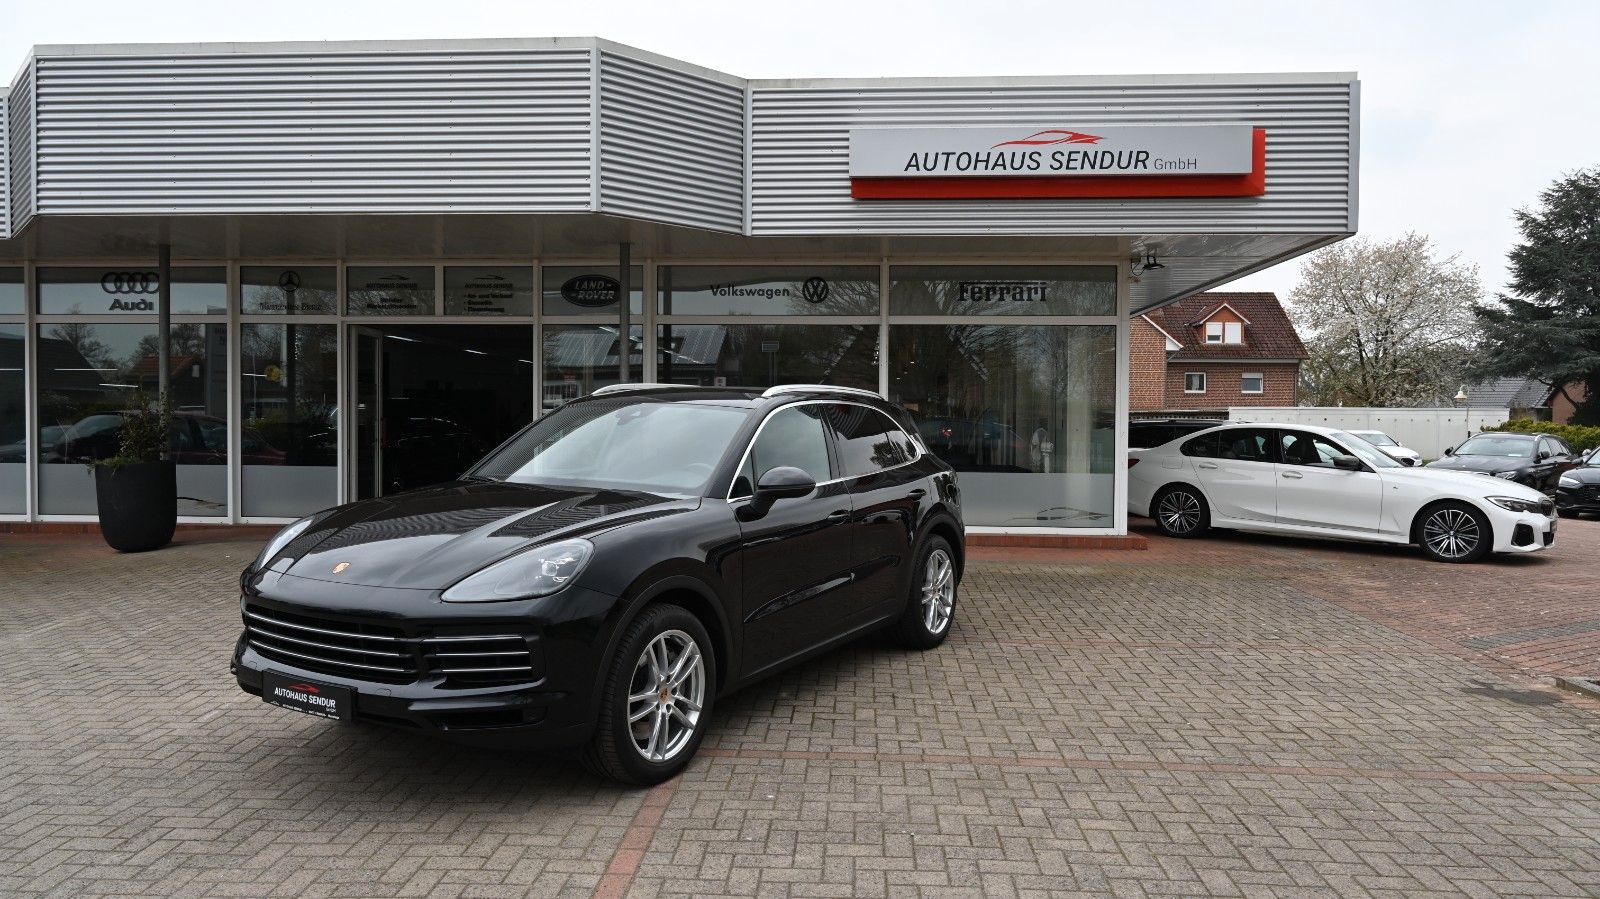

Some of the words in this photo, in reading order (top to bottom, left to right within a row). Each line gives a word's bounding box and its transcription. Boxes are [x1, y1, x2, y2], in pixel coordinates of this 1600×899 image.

[904, 151, 1041, 173] AUTOHAUS
[1049, 149, 1150, 171] SENDUR
[1153, 157, 1198, 171] GmbH
[575, 280, 605, 290] LAND
[710, 284, 790, 299] Volkswagen
[958, 281, 1048, 302] Ferrari
[578, 291, 615, 300] ROVER
[109, 299, 154, 311] Audi
[274, 687, 308, 703] AUTOHAUS
[309, 695, 336, 709] SENDUR
